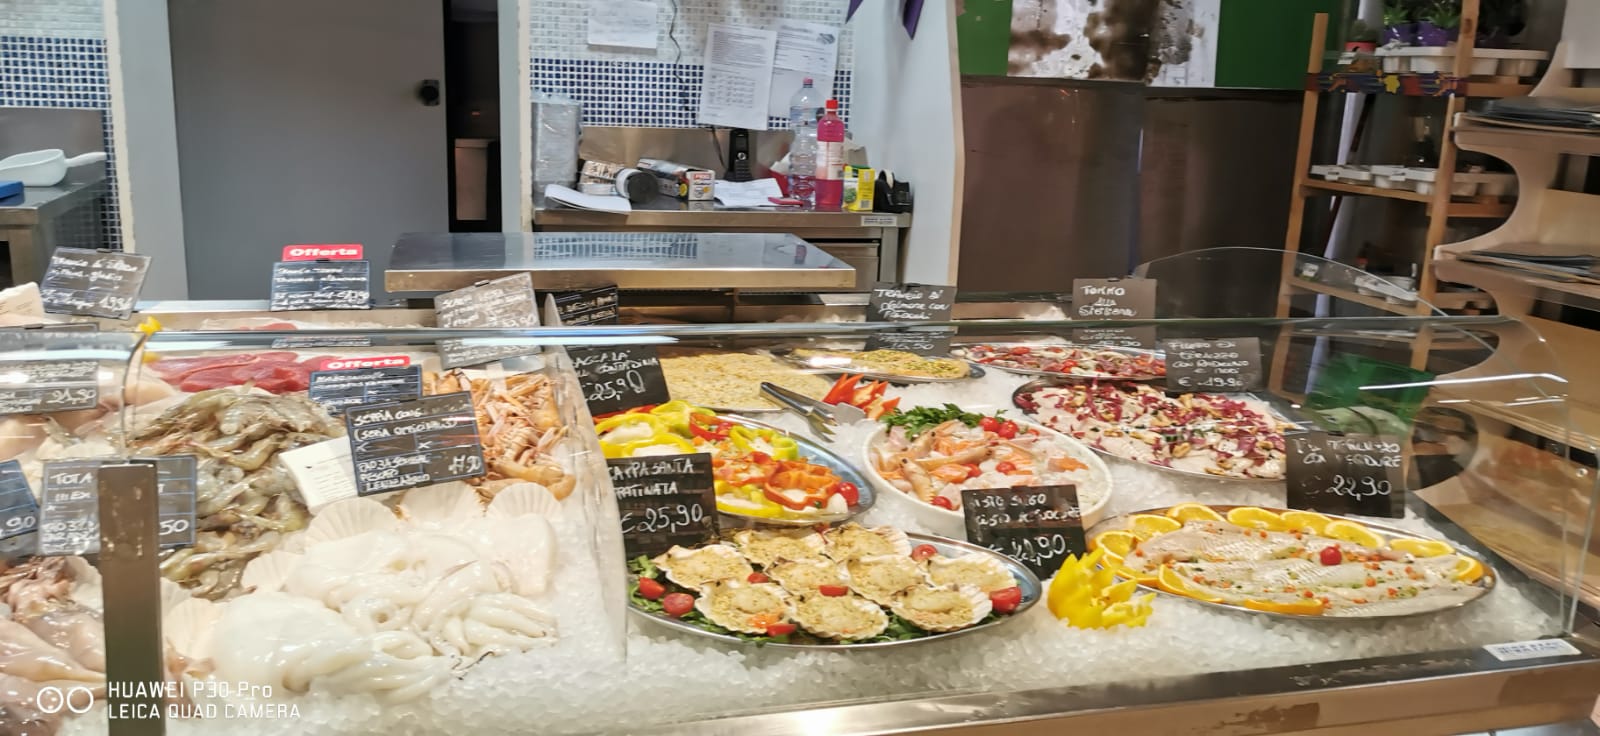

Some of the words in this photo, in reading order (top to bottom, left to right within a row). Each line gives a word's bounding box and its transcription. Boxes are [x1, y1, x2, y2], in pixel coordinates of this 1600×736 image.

[289, 248, 358, 257] Offerta
[327, 358, 405, 370] Offerta
[49, 472, 94, 485] TOTA
[613, 480, 679, 500] RATINATA
[1325, 474, 1392, 502] 22,90
[637, 503, 703, 534] 25,90
